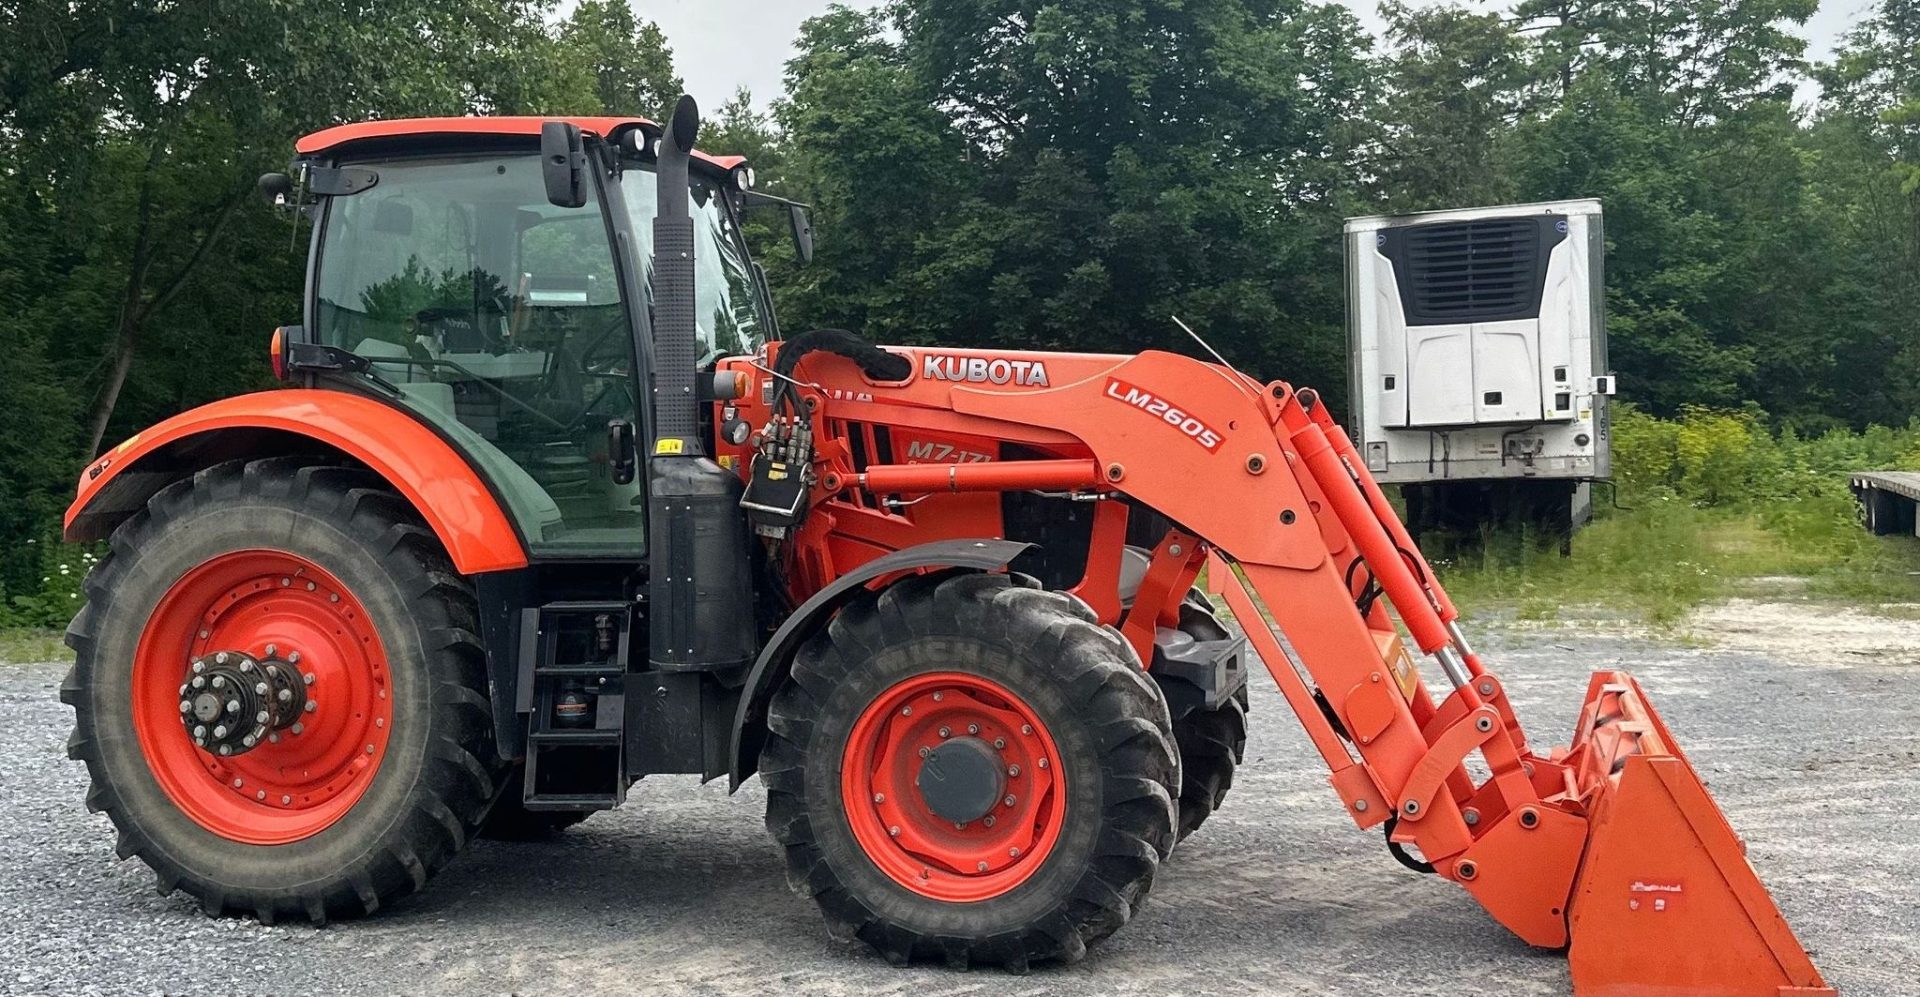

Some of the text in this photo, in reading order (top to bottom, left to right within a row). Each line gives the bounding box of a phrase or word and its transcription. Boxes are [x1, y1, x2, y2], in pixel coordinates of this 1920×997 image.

[923, 355, 1049, 387] KUBOTA
[1107, 382, 1222, 448] LM2605
[1600, 405, 1608, 441] 165
